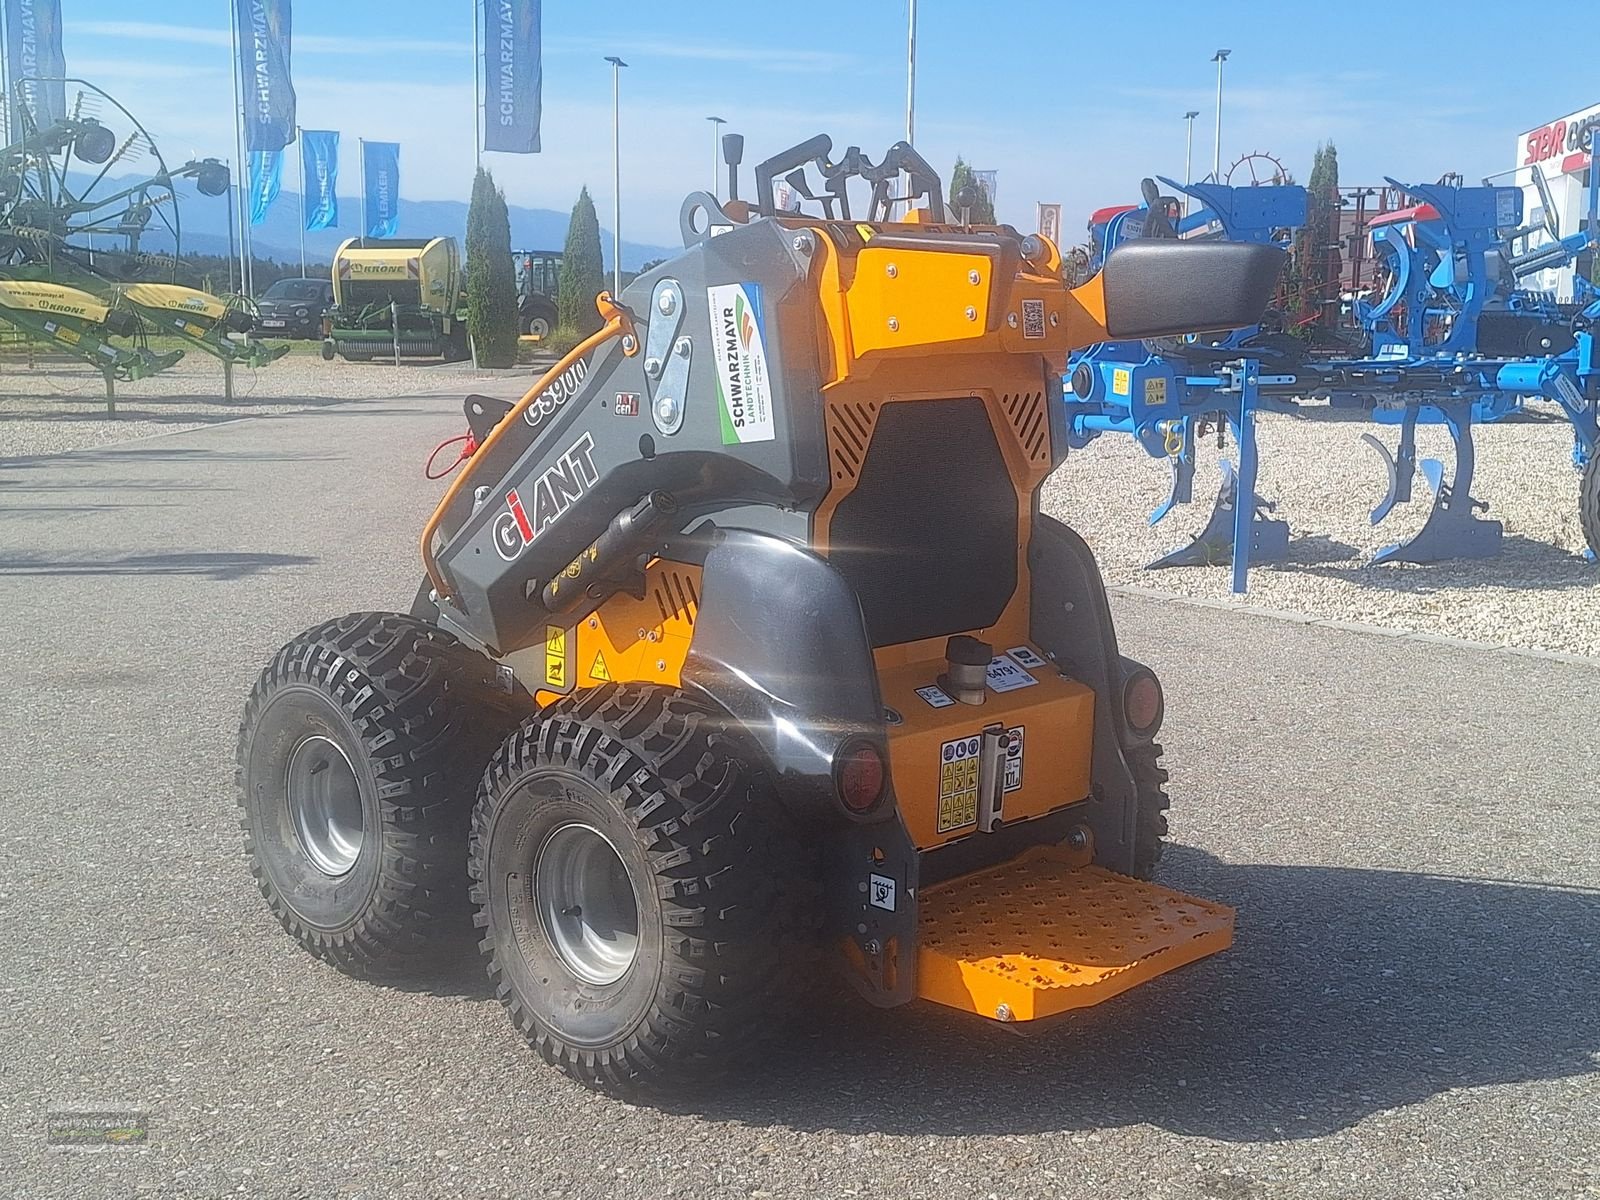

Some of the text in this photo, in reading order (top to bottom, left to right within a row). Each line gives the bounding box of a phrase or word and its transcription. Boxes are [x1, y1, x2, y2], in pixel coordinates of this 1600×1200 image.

[1524, 120, 1567, 166] STEYR
[378, 170, 389, 218] LEMKEN
[364, 265, 405, 273] KRONE
[49, 303, 87, 315] KRONE
[177, 303, 209, 313] KRONE
[723, 307, 745, 428] SCHWARZMAYR
[742, 354, 756, 424] LANDTECHNIK
[987, 665, 1020, 679] 64791
